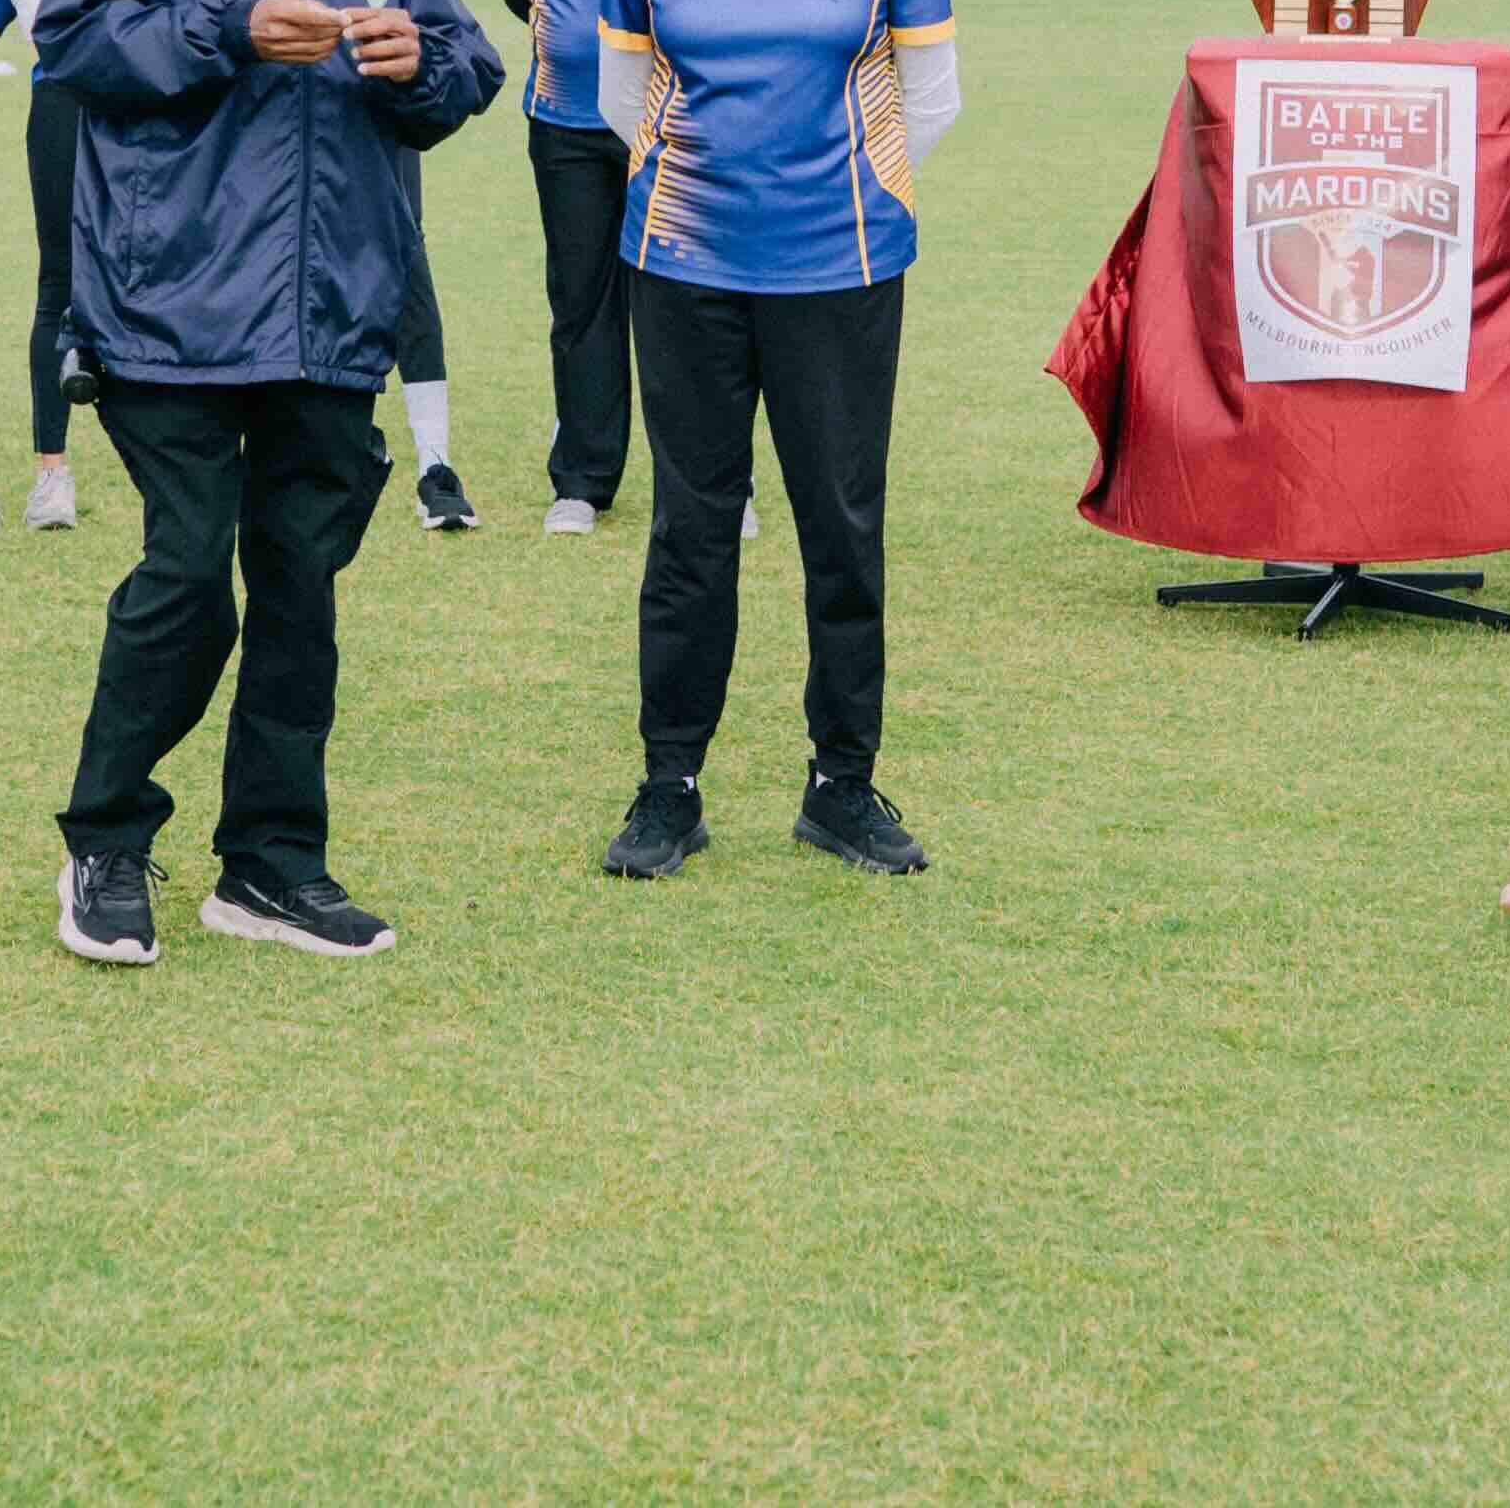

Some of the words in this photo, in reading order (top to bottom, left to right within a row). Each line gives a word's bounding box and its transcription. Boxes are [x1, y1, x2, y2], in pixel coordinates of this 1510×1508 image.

[1280, 99, 1429, 134] BATTLE
[1311, 131, 1346, 146] OF
[1354, 133, 1403, 149] THE
[1256, 174, 1451, 222] MAROONS
[1243, 310, 1344, 356] MELBOURNE
